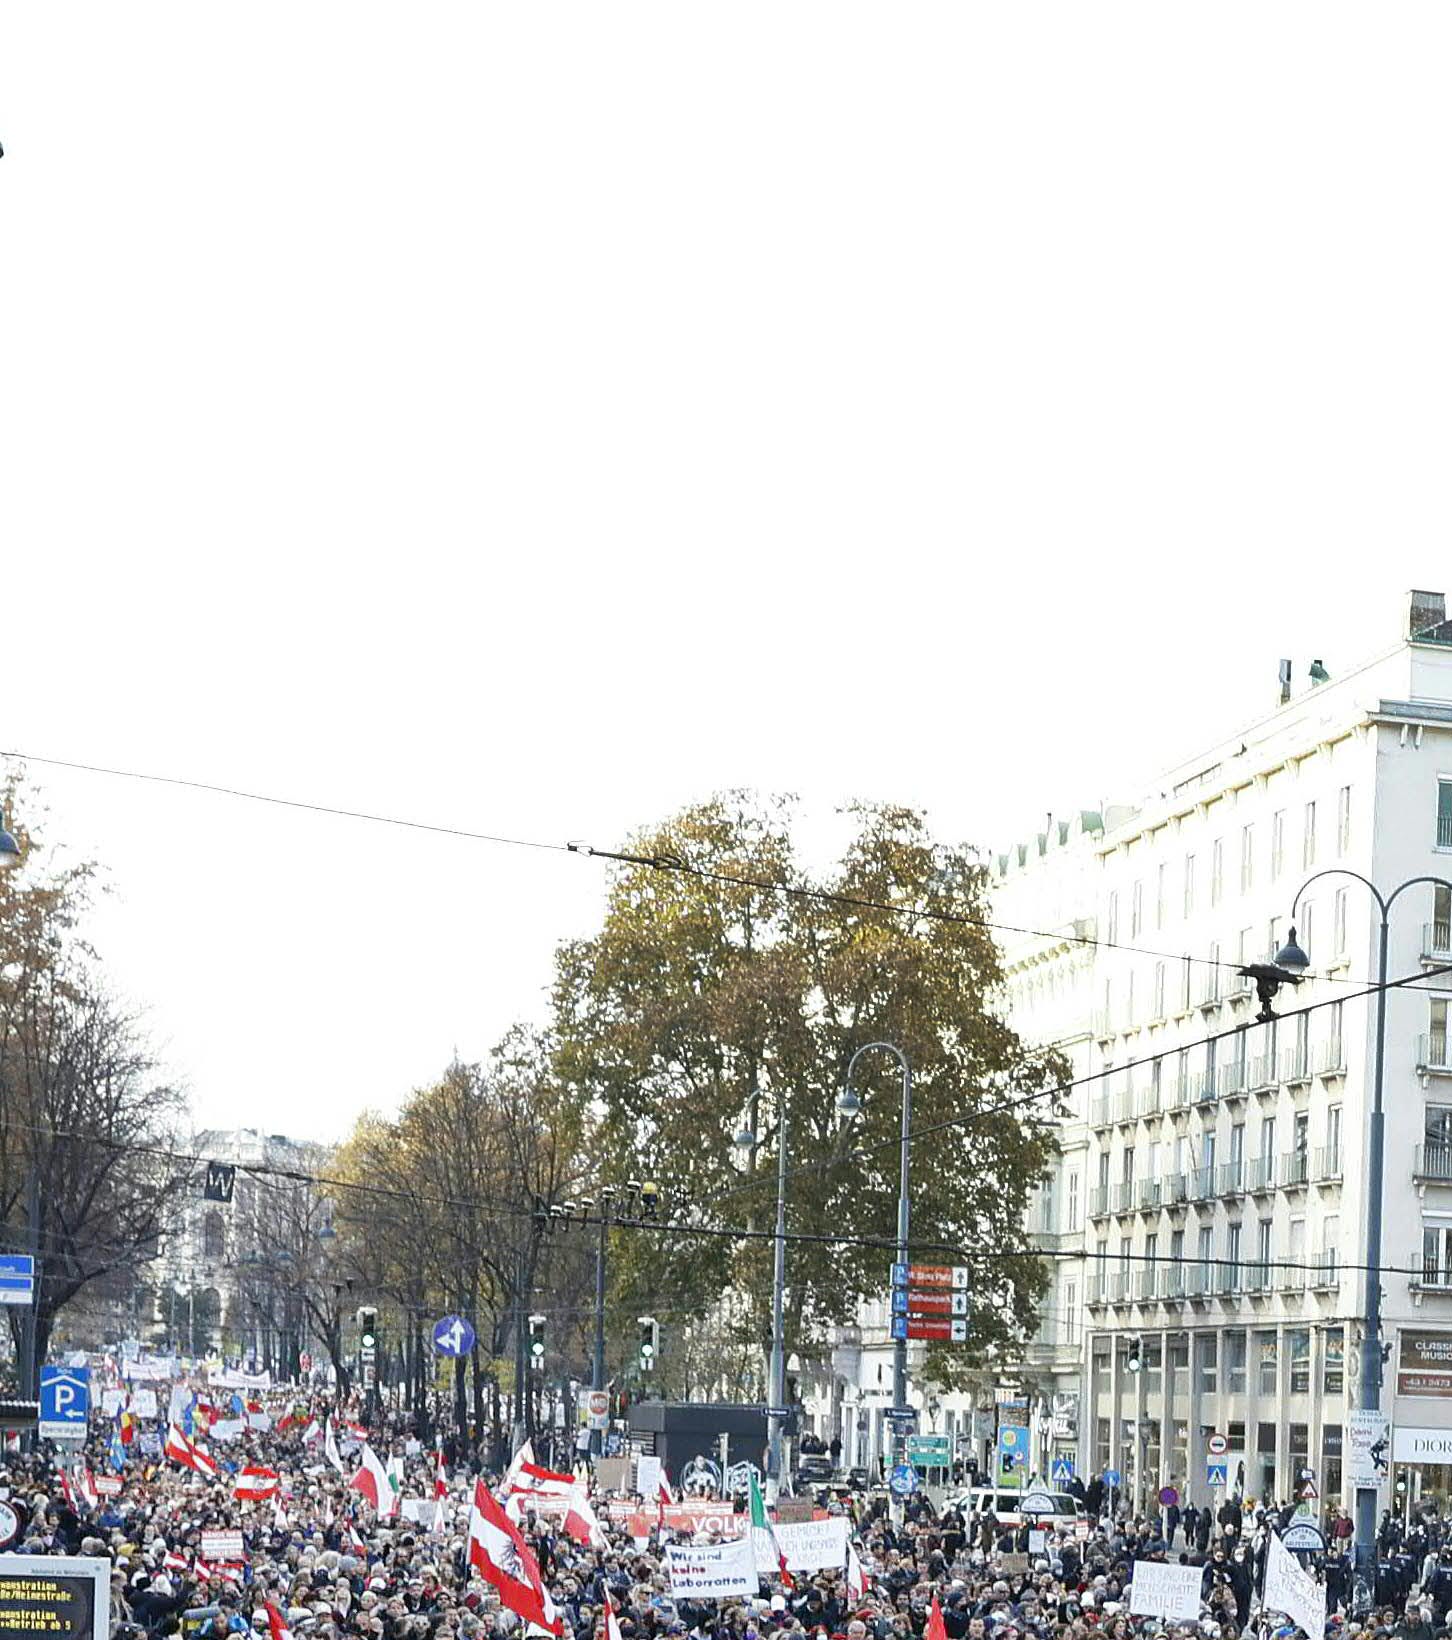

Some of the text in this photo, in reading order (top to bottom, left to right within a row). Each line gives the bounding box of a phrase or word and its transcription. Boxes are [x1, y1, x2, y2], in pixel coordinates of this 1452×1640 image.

[55, 1385, 75, 1413] P
[1414, 1439, 1452, 1453] DIOR
[671, 1551, 722, 1562] Wir sind
[671, 1564, 706, 1575] keine
[673, 1576, 747, 1588] Laborratten
